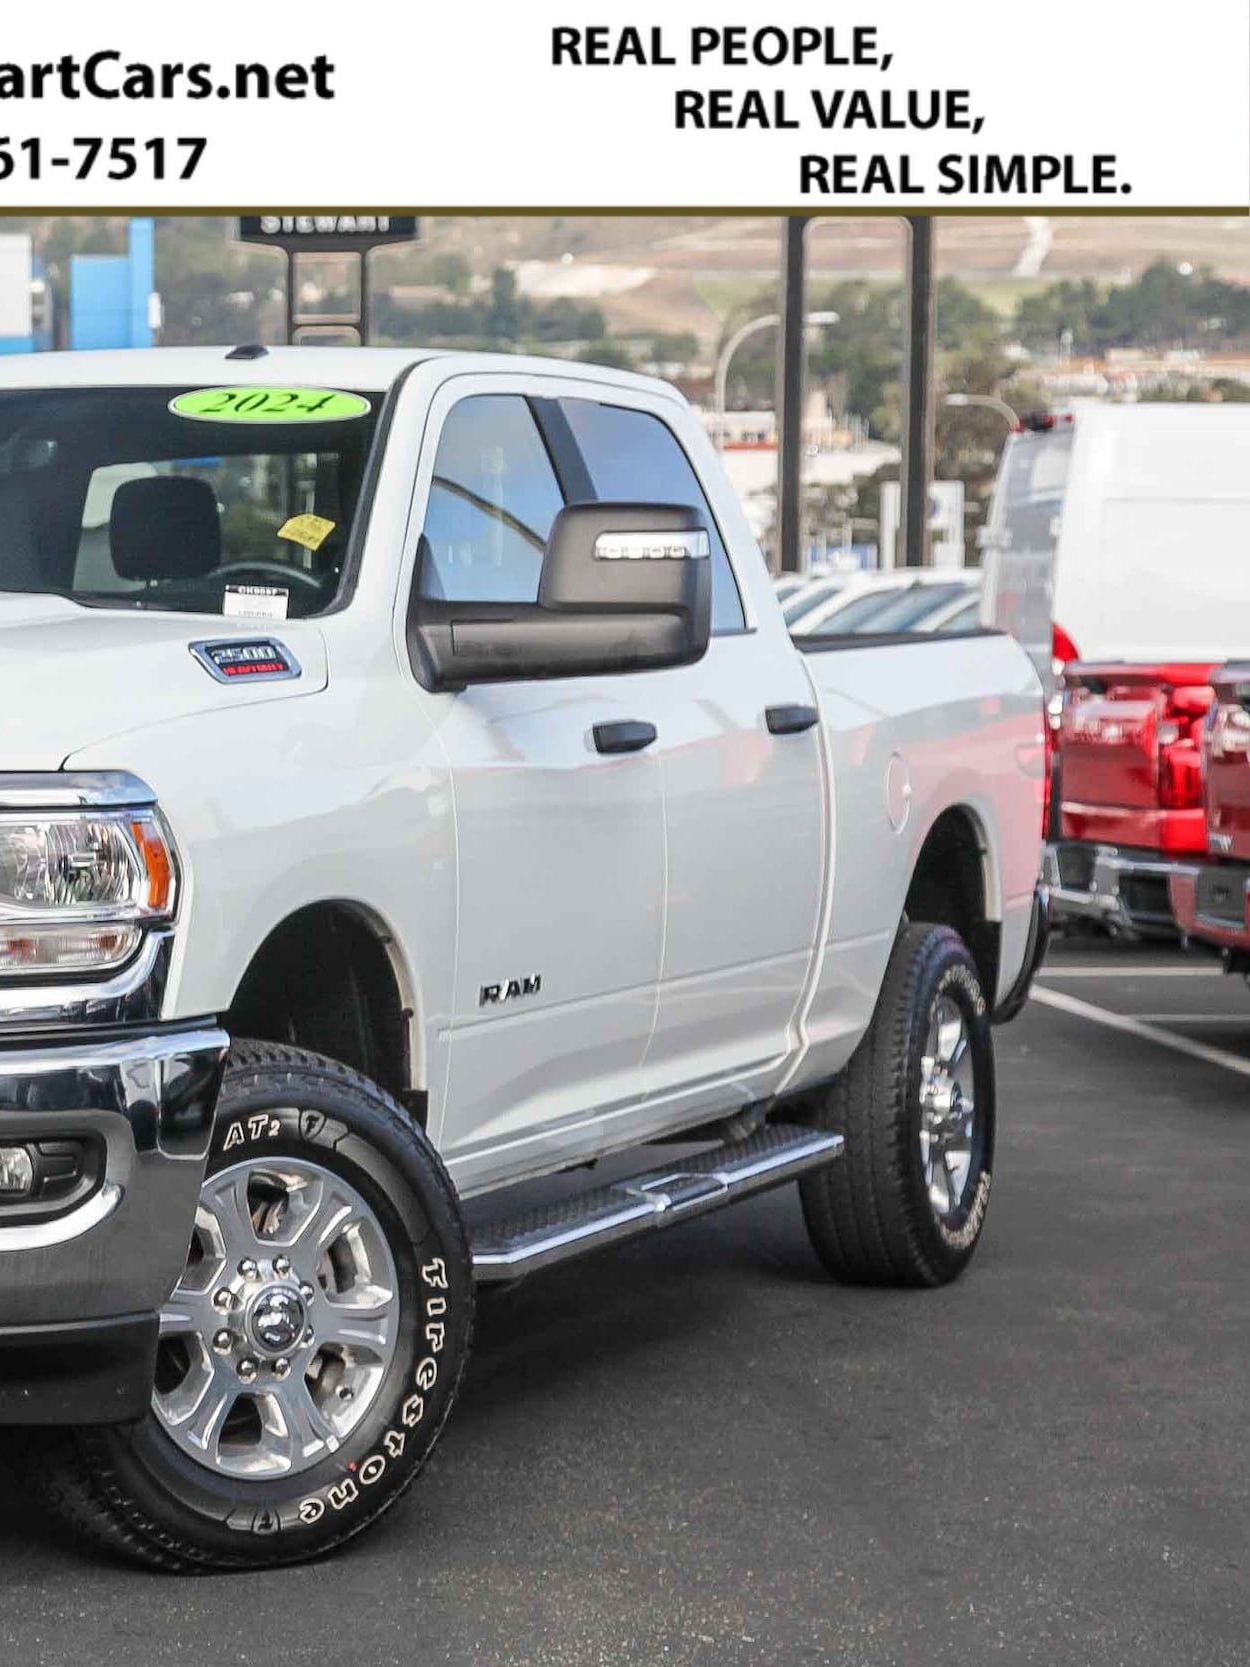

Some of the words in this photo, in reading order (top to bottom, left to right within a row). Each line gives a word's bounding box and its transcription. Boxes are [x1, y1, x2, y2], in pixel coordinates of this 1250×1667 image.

[199, 392, 337, 412] 2024
[211, 646, 277, 665] 2500
[478, 973, 541, 1008] RAM
[299, 1257, 448, 1524] Firestone
